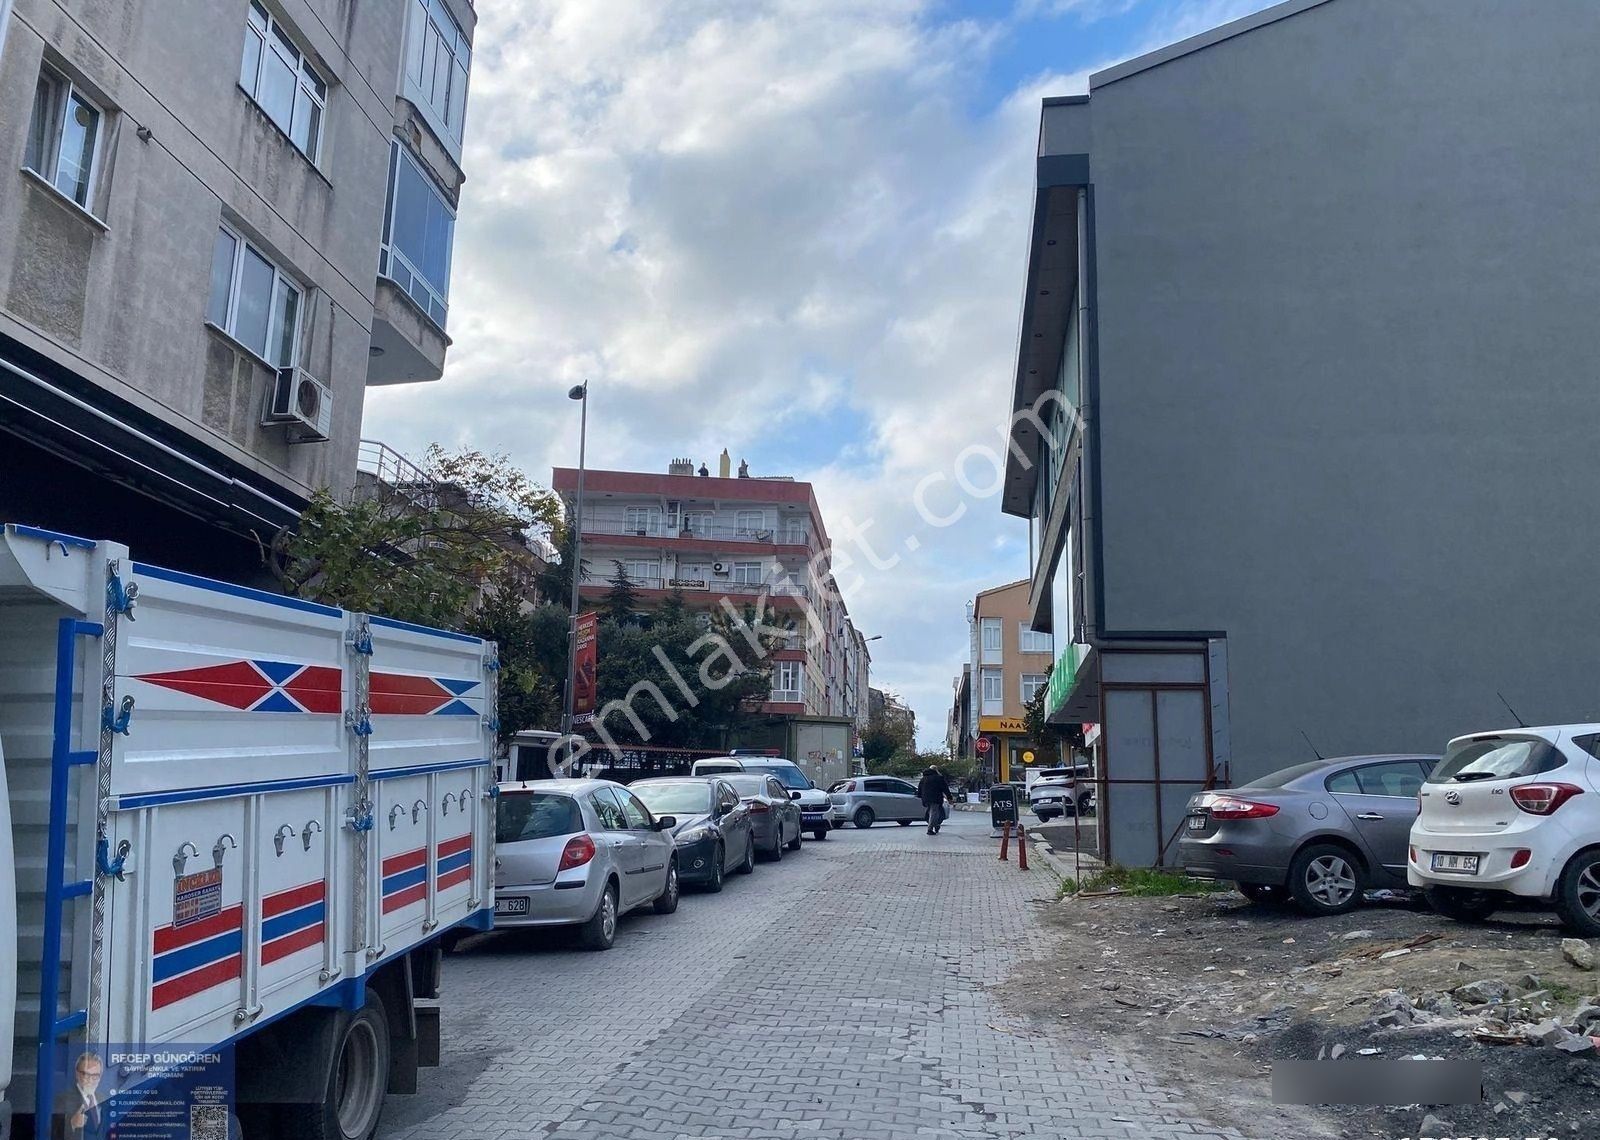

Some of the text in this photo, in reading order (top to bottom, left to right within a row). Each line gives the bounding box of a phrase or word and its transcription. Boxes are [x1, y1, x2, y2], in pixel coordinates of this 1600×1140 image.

[993, 800, 1013, 808] ATS
[1463, 857, 1476, 869] 654
[508, 900, 525, 911] 628
